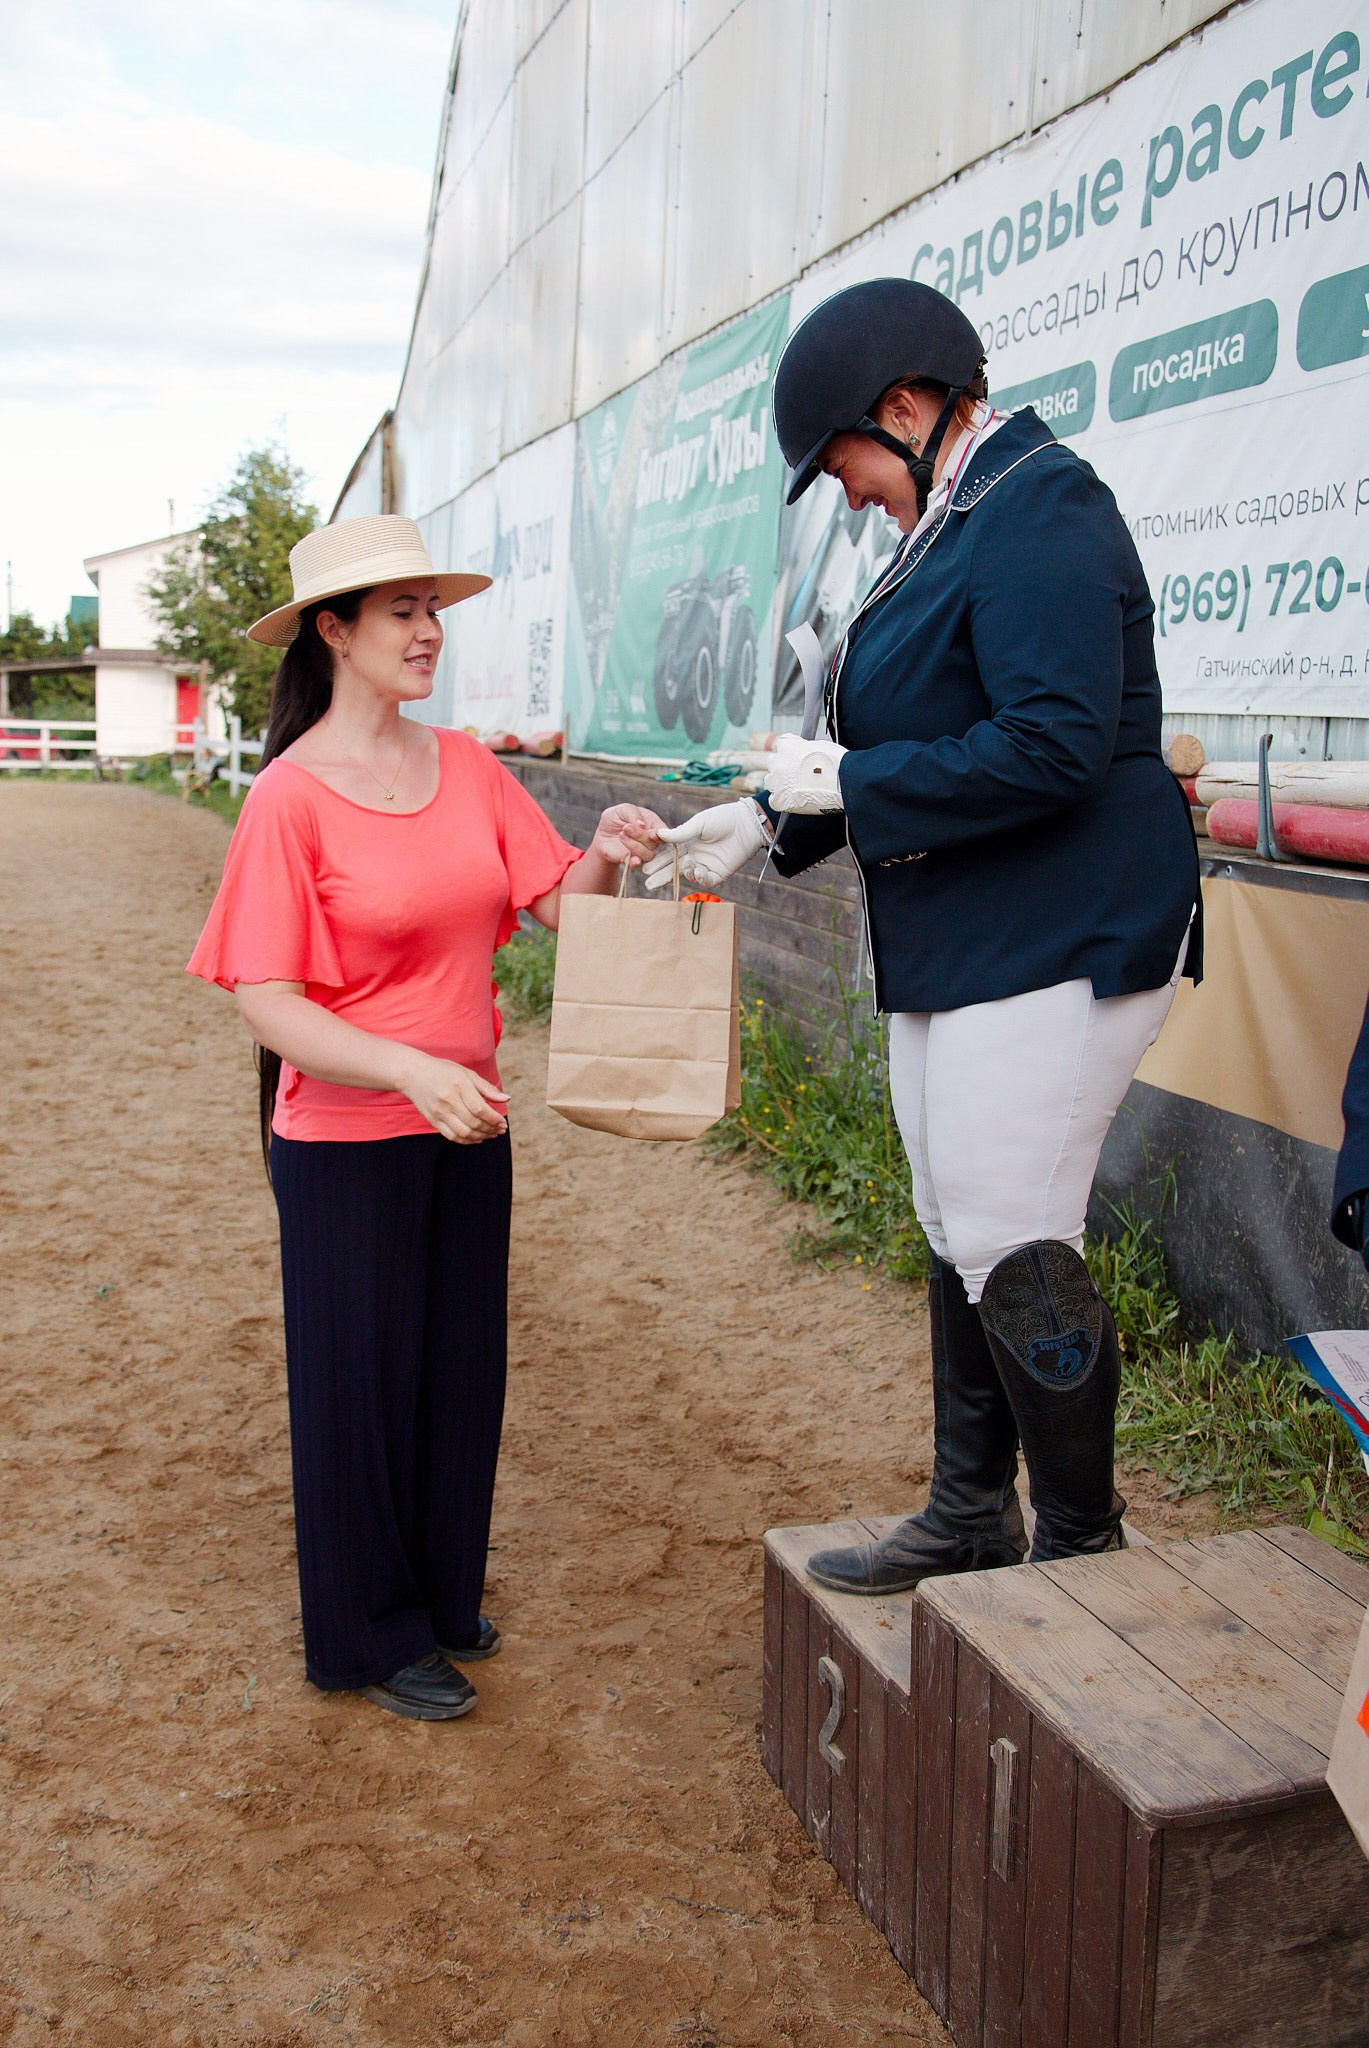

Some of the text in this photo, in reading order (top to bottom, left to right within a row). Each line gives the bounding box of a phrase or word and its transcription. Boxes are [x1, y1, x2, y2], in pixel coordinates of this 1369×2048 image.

[1140, 30, 1369, 229] расте
[979, 271, 1107, 355] рассады
[1116, 248, 1164, 313] до
[1132, 332, 1245, 394] посадка
[1002, 387, 1079, 421] авка
[708, 407, 768, 488] Туры
[1121, 502, 1229, 541] итомник
[1235, 481, 1347, 527] садовых
[1159, 556, 1369, 637] (969) 720-
[1195, 651, 1295, 678] Гатчинский
[1299, 655, 1334, 681] р-н,
[1339, 655, 1358, 677] д.
[817, 1655, 847, 1776] 2
[989, 1737, 1018, 1883] 1
